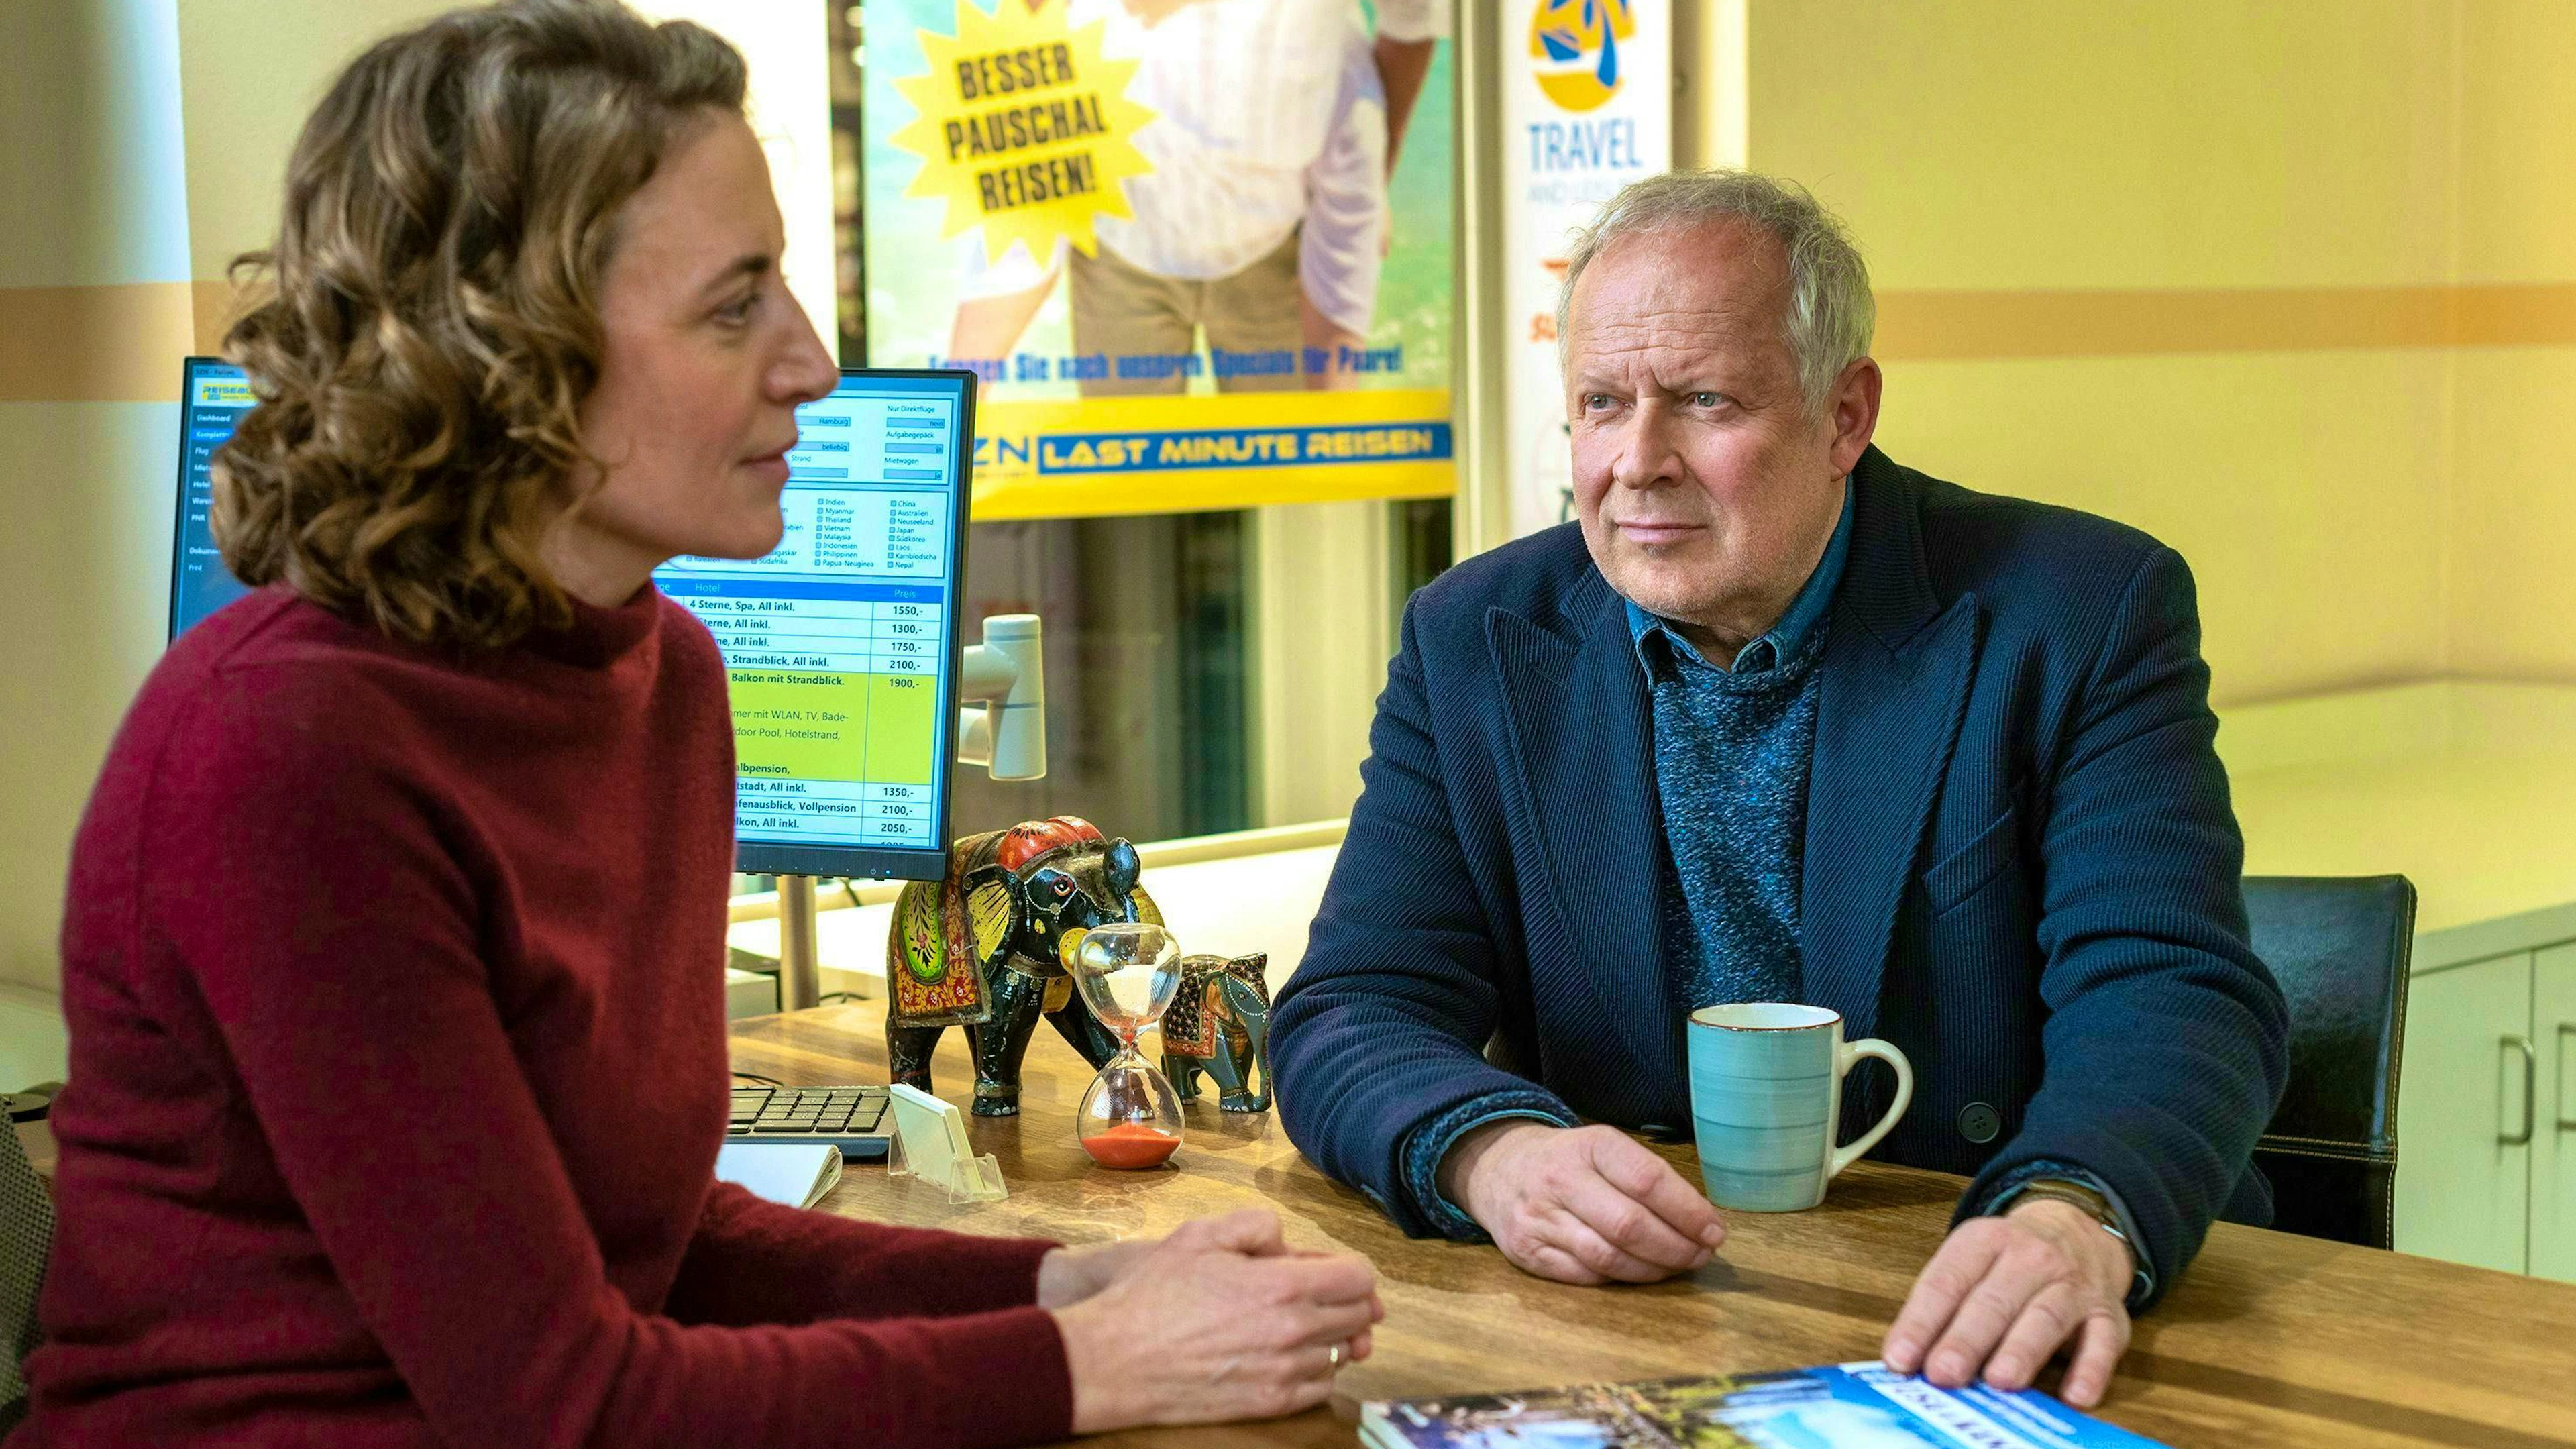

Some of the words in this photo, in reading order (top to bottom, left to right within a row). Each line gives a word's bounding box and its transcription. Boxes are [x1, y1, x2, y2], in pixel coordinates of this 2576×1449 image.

[957, 44, 1074, 101] BESSER
[945, 95, 1106, 163] PAUSCHAL
[1529, 117, 1642, 172] TRAVEL
[979, 154, 1097, 212] REISEN!
[1016, 353, 1049, 381] Sie
[1059, 353, 1108, 380] nach
[1339, 343, 1403, 373] Paare!
[901, 406, 935, 414] Direktflüge
[197, 414, 231, 422] Dashboard
[819, 419, 849, 427] Hamburg
[886, 431, 934, 439] Aufgabegepäck
[195, 447, 209, 456] Flug
[1042, 439, 1150, 468] LAST
[1159, 433, 1297, 463] MINUTE
[1307, 429, 1432, 458] REISEN
[696, 583, 720, 592] Hotel
[894, 588, 916, 598] Preis
[690, 600, 696, 608] 4
[699, 600, 731, 610] Sterne,
[735, 601, 755, 612] Spa,
[759, 602, 771, 610] All
[775, 602, 794, 611] inkl.
[893, 606, 923, 616] 1550,-
[735, 619, 747, 628] All
[751, 619, 770, 629] inkl.
[892, 624, 922, 634] 1300,-
[733, 637, 747, 646] All
[749, 638, 769, 647] inkl.
[892, 642, 921, 652] 1750,-
[733, 655, 790, 666] Strandblick,
[793, 657, 806, 665] All
[809, 658, 829, 667] inkl.
[890, 660, 920, 670] 2100,-
[732, 673, 764, 683] Balkon
[767, 674, 784, 683] mit
[787, 675, 845, 686] Strandblick.
[889, 678, 920, 688] 1900,-
[754, 710, 768, 718] mit
[771, 711, 802, 720] WLAN,
[806, 712, 818, 721] TV,
[822, 712, 849, 721] Bade-
[759, 729, 782, 738] Pool,
[785, 729, 840, 741] Hotelstrand,
[770, 783, 782, 792] All
[786, 784, 806, 793] inkl.
[883, 788, 914, 798] 1350,-
[799, 802, 856, 814] Vollpension
[882, 806, 912, 815] 2100,-
[763, 818, 775, 827] All
[779, 819, 799, 828] inkl.
[881, 824, 912, 834] 2050,-
